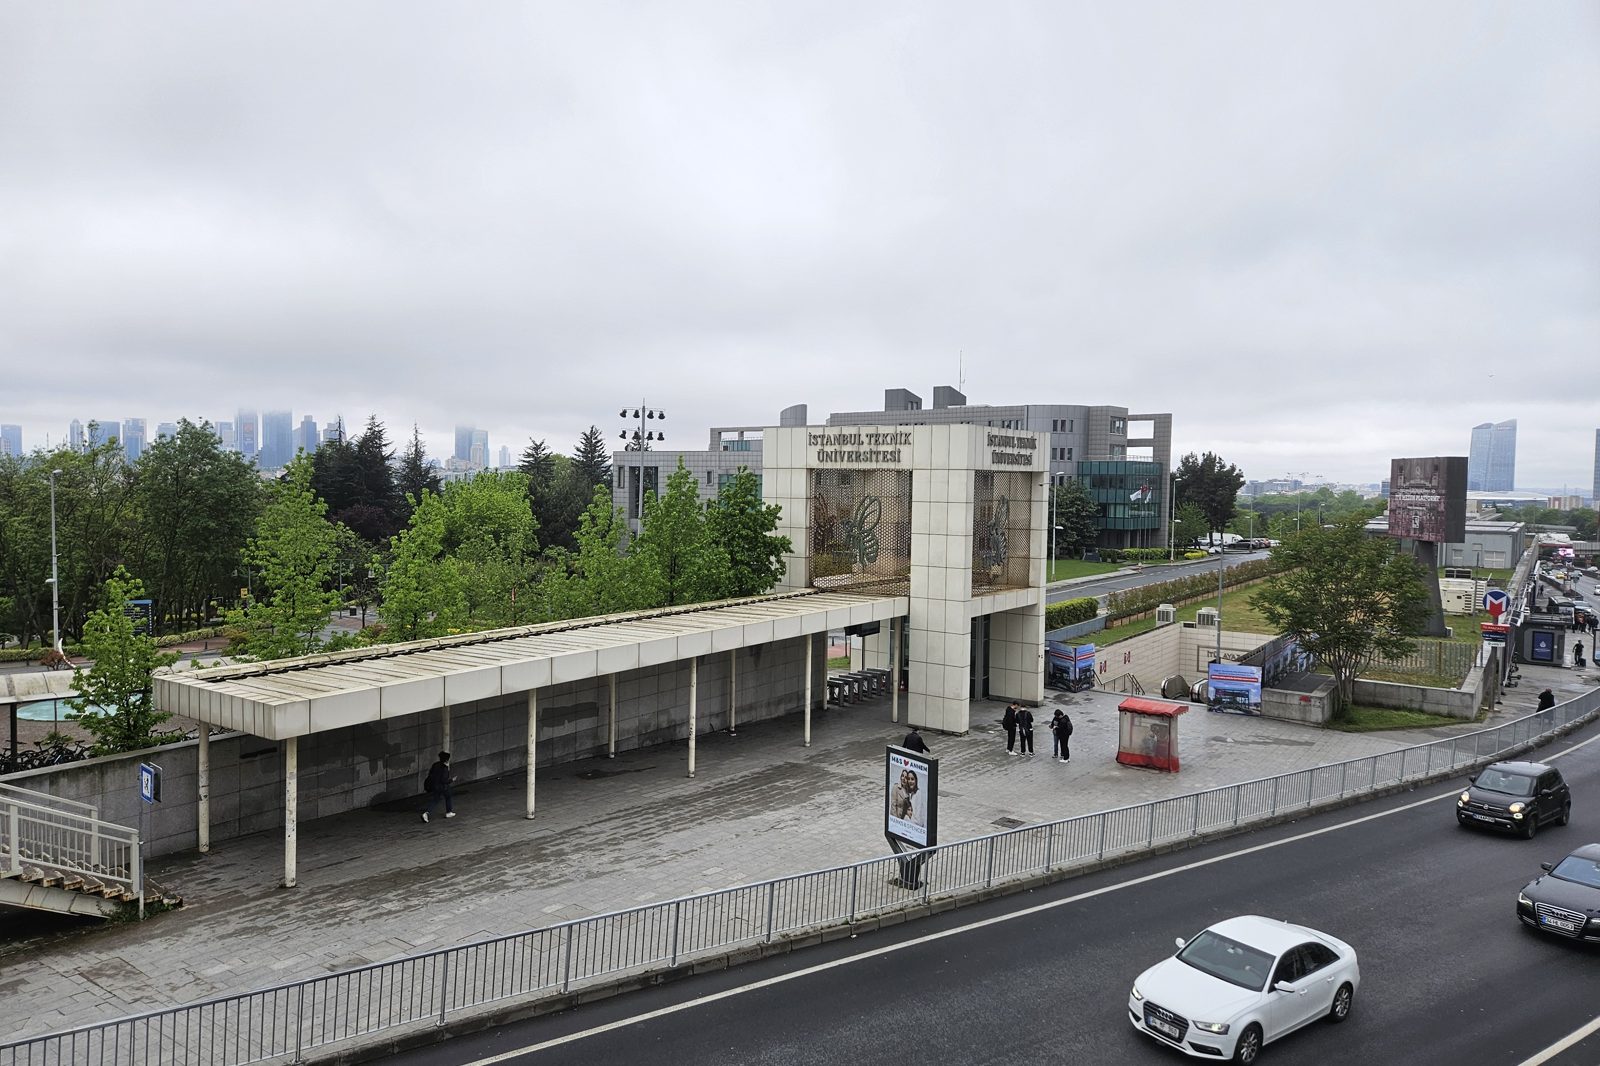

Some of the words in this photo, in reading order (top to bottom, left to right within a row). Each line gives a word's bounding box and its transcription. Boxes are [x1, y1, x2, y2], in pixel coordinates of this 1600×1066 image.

[808, 432, 864, 446] İSTANBUL
[866, 430, 912, 446] TEKNİK
[987, 432, 1016, 448] İSTANBUL
[1016, 436, 1037, 449] TEKNİK
[817, 448, 902, 463] ÜNİVERSİTESİ
[992, 450, 1033, 466] ÜNİVERSİTESİ
[891, 755, 903, 765] M&S
[910, 762, 928, 772] ANNEM
